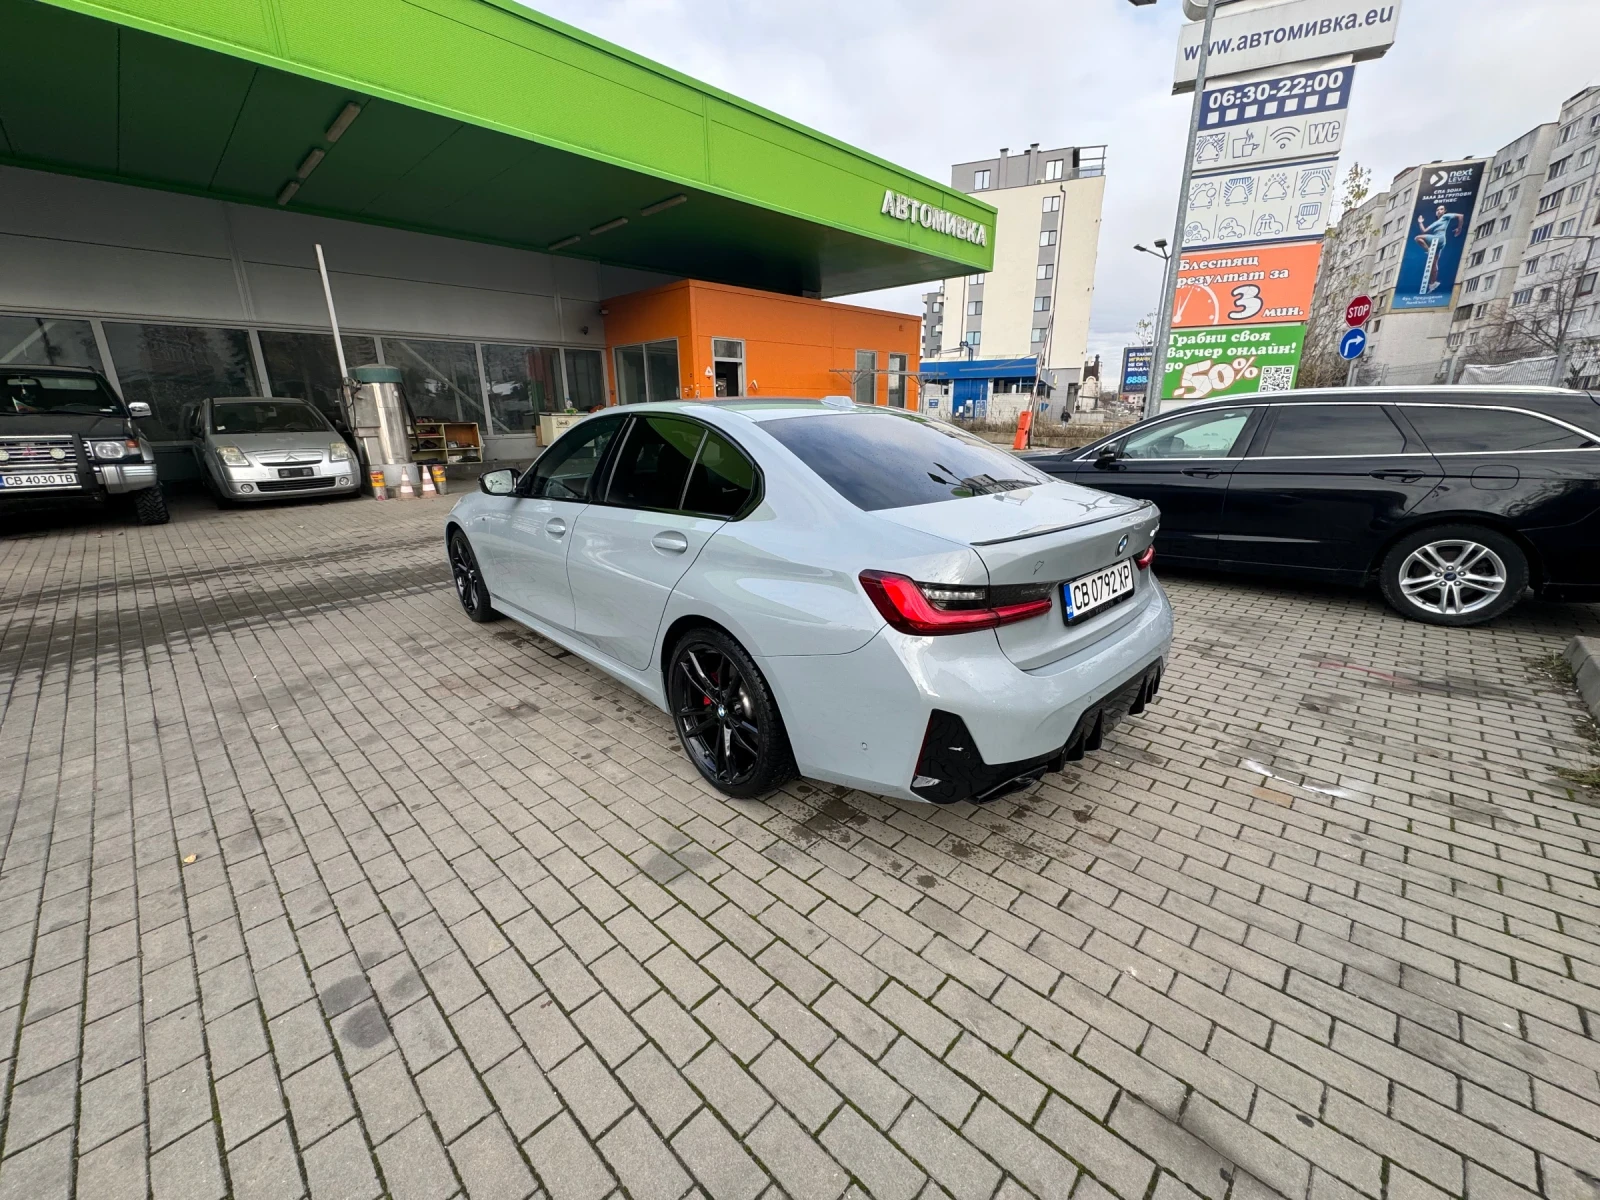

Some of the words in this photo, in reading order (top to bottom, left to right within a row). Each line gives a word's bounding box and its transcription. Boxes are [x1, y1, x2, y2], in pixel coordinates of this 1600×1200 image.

[1209, 71, 1343, 109] 06:30-22:00
[1308, 120, 1341, 145] WC
[1449, 168, 1473, 177] next
[881, 189, 987, 247] АВТОМИВКА
[1178, 256, 1259, 271] Блестящ
[1176, 270, 1265, 289] резултат
[1269, 269, 1289, 279] за
[1228, 284, 1263, 320] 3
[1262, 306, 1304, 318] мин.
[1347, 304, 1369, 318] STOP
[1168, 332, 1227, 346] Грабни
[1231, 330, 1271, 342] своя
[1166, 346, 1223, 360] ваучер
[1226, 342, 1297, 357] онлайн!
[1164, 361, 1184, 373] до
[1172, 356, 1260, 399] 50%
[5, 476, 23, 486] CB
[25, 475, 55, 484] 4030
[57, 474, 74, 483] TB
[1073, 582, 1090, 610] CB
[1091, 570, 1118, 602] 0792
[1117, 565, 1130, 590] XP
